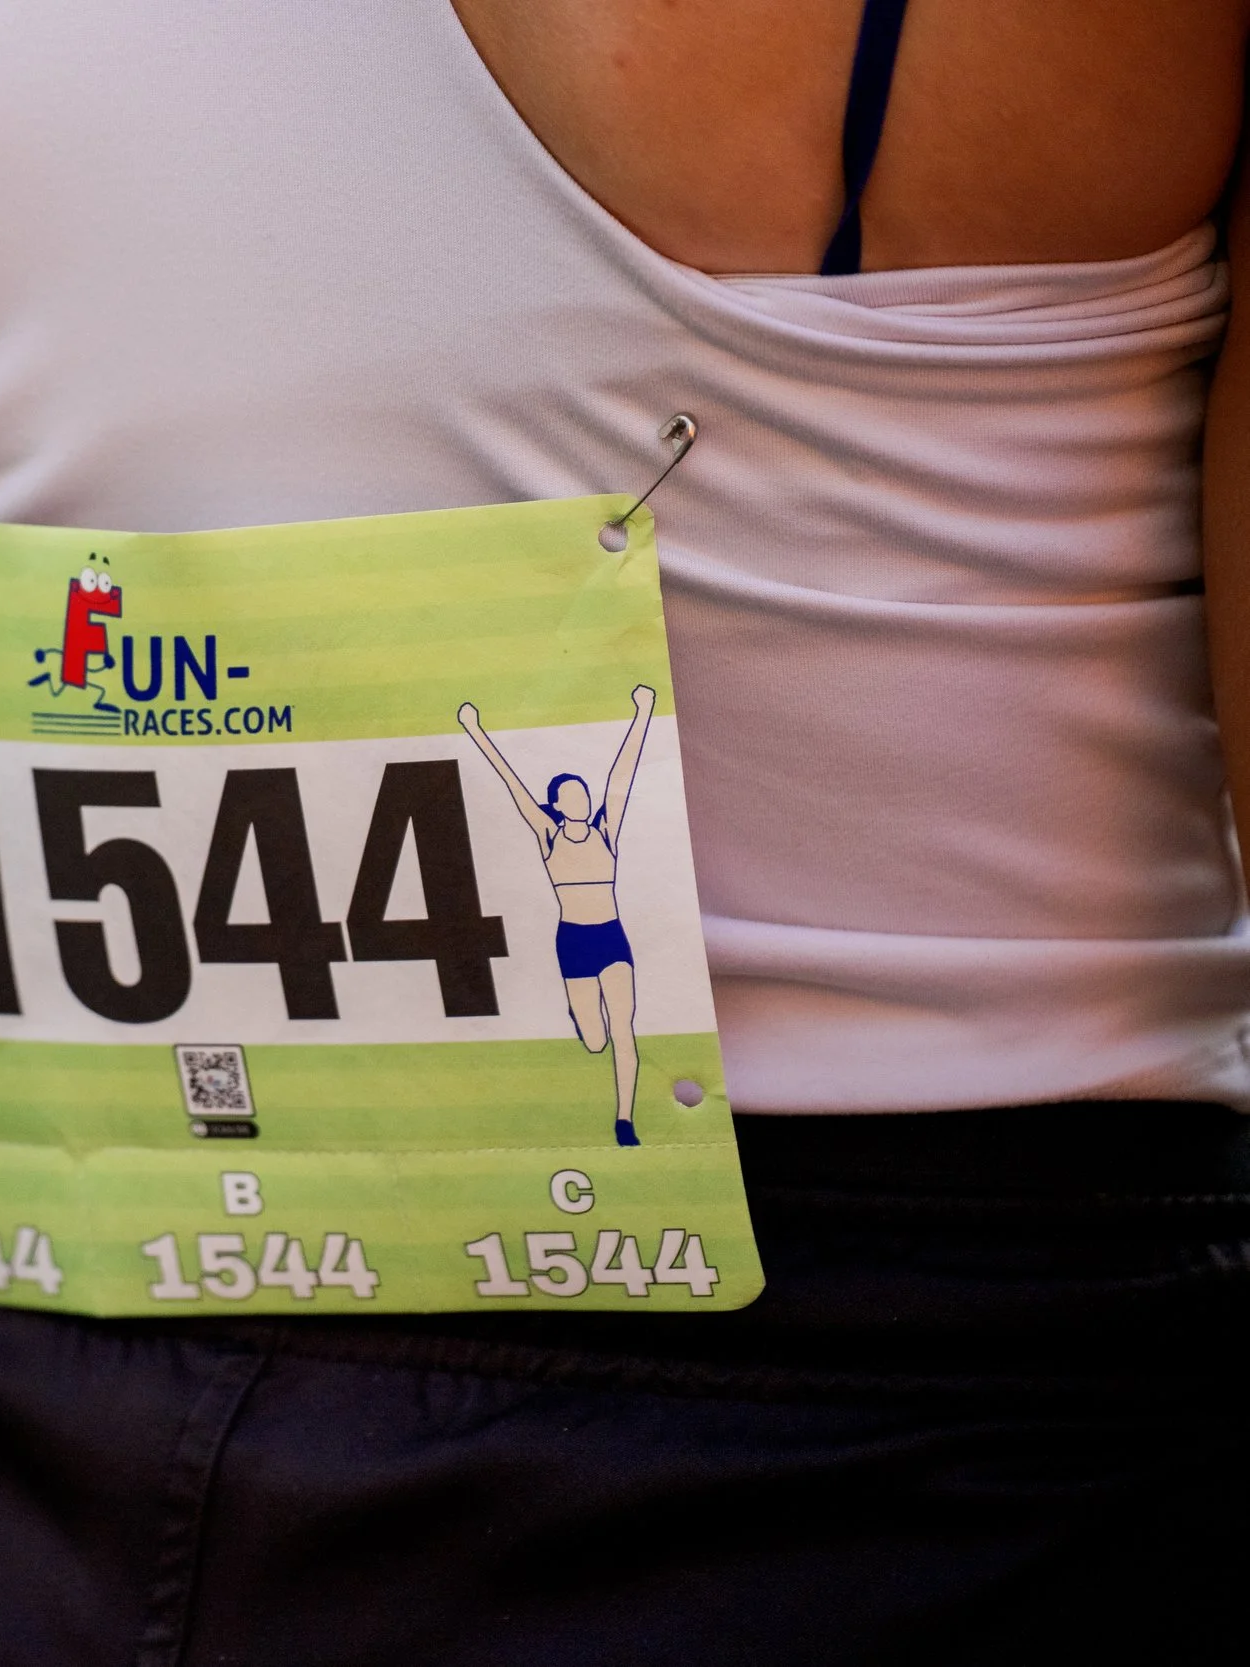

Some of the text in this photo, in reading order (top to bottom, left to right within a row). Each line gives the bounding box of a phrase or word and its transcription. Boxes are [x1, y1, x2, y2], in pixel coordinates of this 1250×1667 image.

[123, 706, 293, 735] RACES.COM
[221, 1172, 263, 1215] B
[550, 1169, 595, 1213] C
[142, 1232, 380, 1300] 1544
[464, 1229, 718, 1298] 1544
